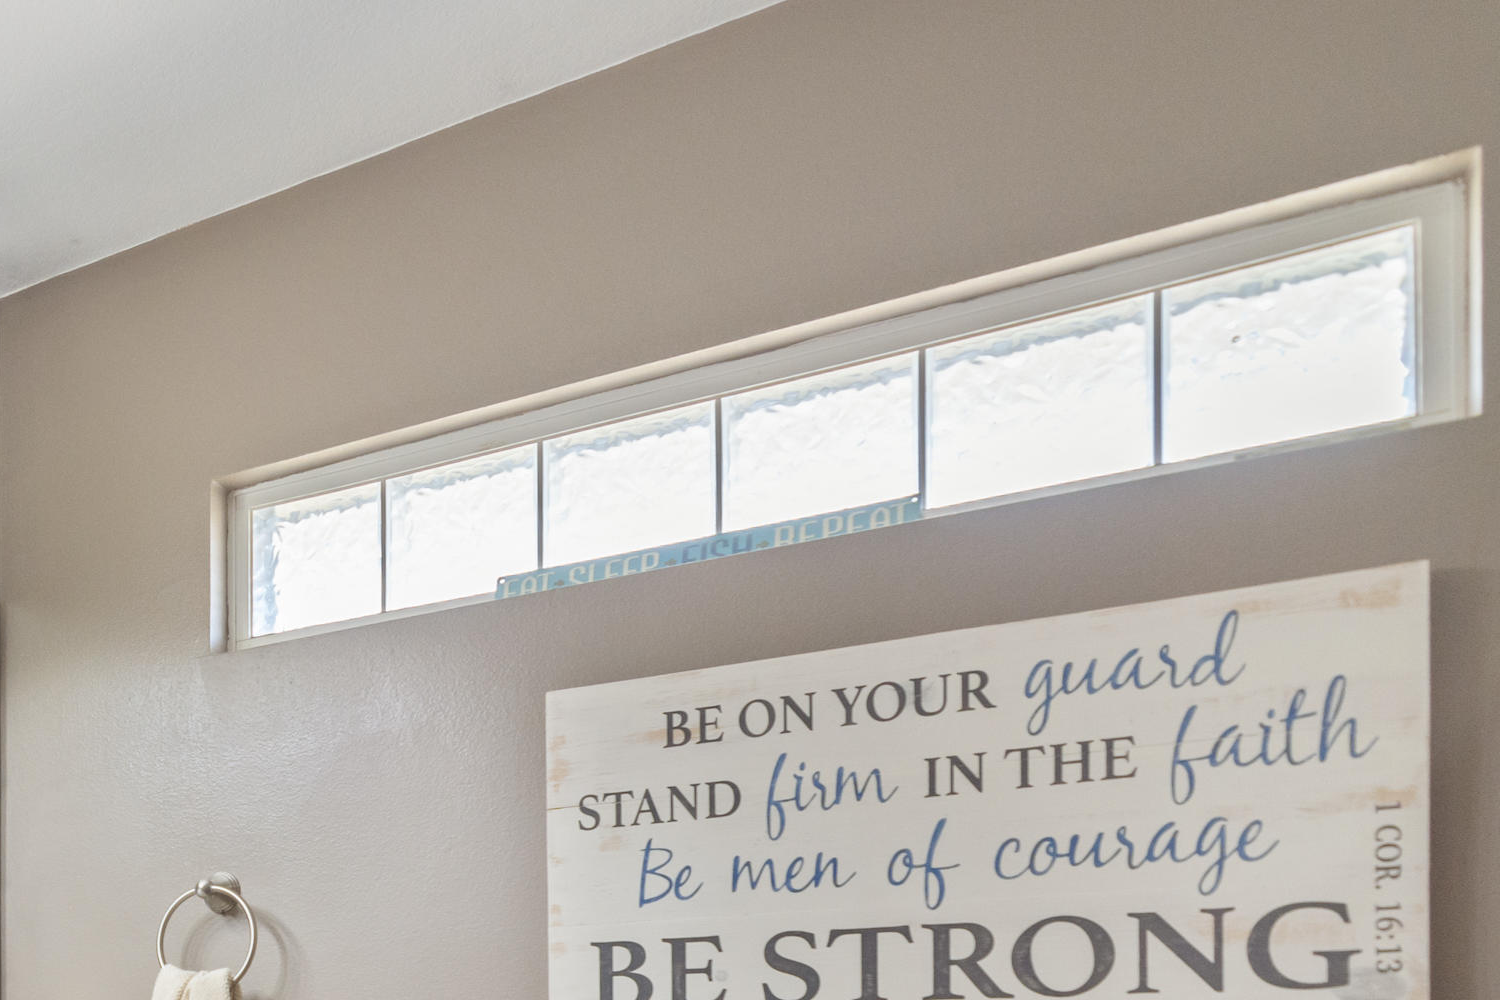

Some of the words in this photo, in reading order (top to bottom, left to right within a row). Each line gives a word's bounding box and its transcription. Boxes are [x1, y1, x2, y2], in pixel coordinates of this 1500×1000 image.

[662, 704, 725, 748] BE
[737, 691, 818, 738] ON
[831, 669, 997, 727] YOUR
[1024, 609, 1247, 736] guard
[577, 779, 742, 831] STAND
[765, 752, 899, 841] firm
[923, 752, 988, 798] IN
[1003, 735, 1139, 789] THE
[1170, 674, 1380, 805] faith
[1375, 801, 1402, 813] 1
[638, 838, 704, 908] Be
[731, 852, 857, 894] men
[887, 818, 961, 910] of
[993, 816, 1280, 897] courage
[1374, 824, 1403, 890] COR.
[1374, 902, 1404, 974] 16:13
